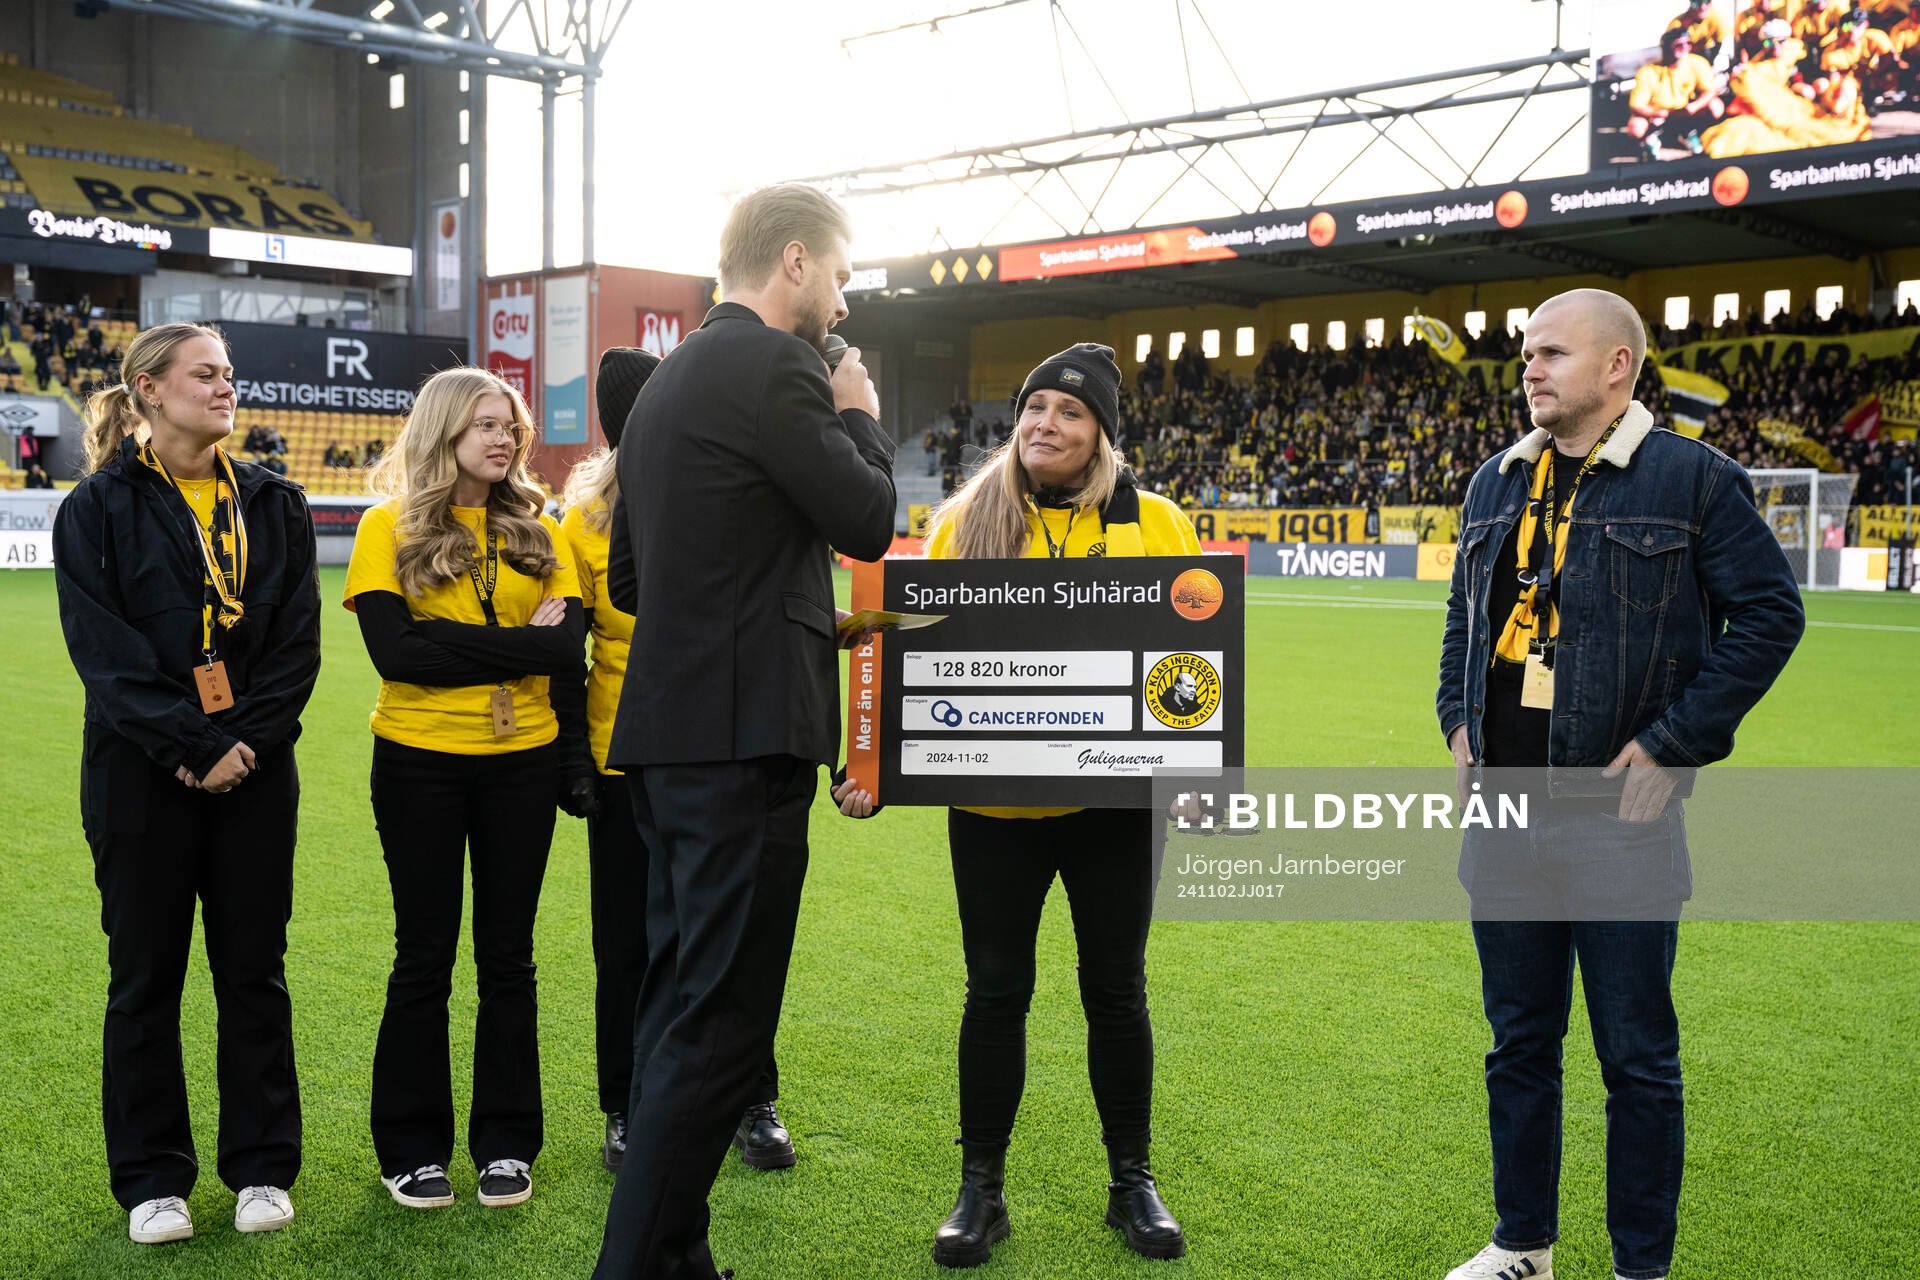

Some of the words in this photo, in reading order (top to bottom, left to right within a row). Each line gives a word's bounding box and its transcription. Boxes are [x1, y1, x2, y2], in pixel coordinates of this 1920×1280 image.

[1769, 161, 1871, 191] Sparbanken
[73, 176, 354, 237] BORÅS
[1550, 186, 1638, 214] Sparbanken
[1639, 177, 1710, 205] Sjuhärad
[1356, 208, 1433, 234] Sparbanken
[1433, 200, 1494, 226] Sjuhärad
[1187, 229, 1254, 251] Sparbanken
[327, 336, 373, 381] FR
[1278, 512, 1349, 543] 1991
[1277, 541, 1386, 578] TÅNGEN
[904, 581, 1046, 610] Sparbanken
[1053, 580, 1161, 609] Sjuhärad
[858, 640, 873, 657] b
[861, 661, 873, 684] en
[932, 661, 965, 677] 128
[970, 661, 1004, 677] 820
[1009, 660, 1068, 677] kronor
[1149, 661, 1169, 687] KLAS
[1170, 656, 1217, 686] INGESSON
[857, 688, 873, 711] än
[1149, 698, 1169, 720] KEEP
[1172, 718, 1192, 726] THE
[1194, 698, 1217, 723] FAITH
[855, 714, 873, 751] Mer
[968, 711, 1104, 725] CANCERFONDEN
[926, 752, 989, 763] 2024-11-02
[1077, 748, 1165, 769] Guliganerna
